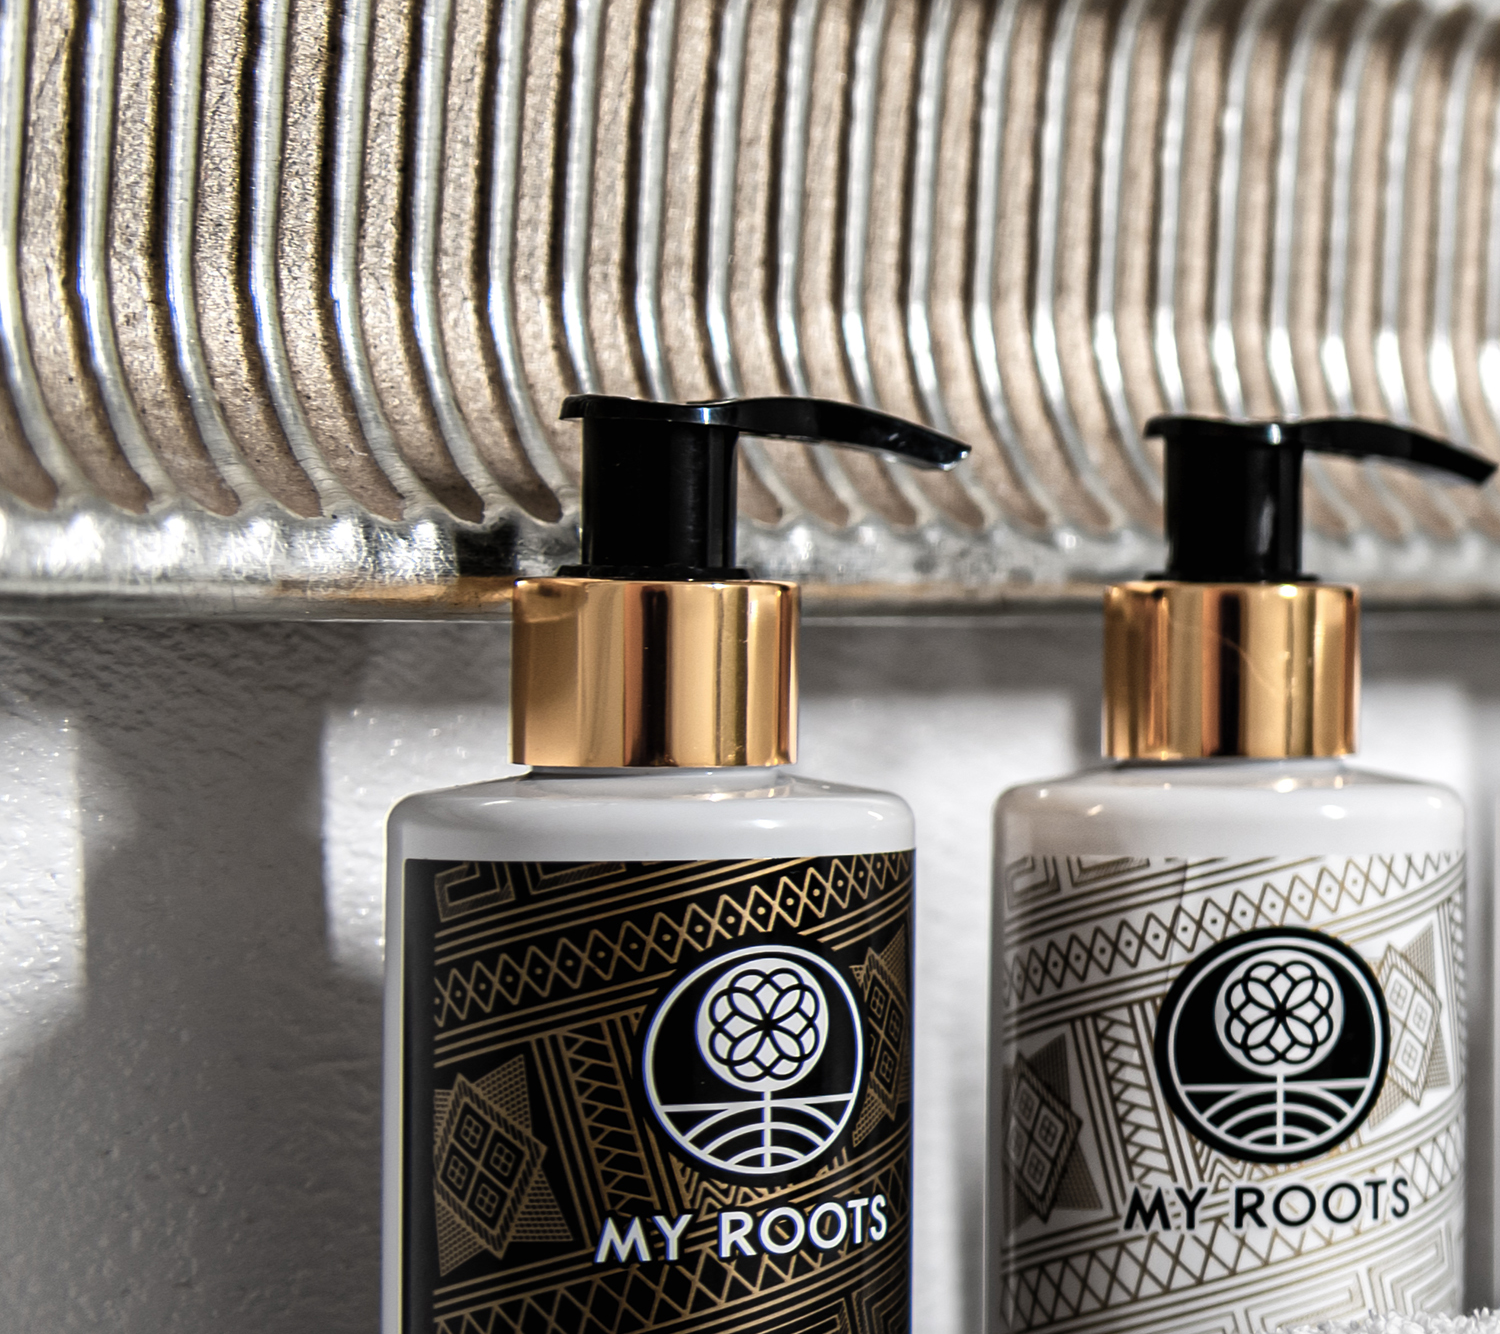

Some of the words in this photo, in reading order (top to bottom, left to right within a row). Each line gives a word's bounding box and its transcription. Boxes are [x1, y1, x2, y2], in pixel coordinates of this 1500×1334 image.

[595, 1214, 692, 1264] MY
[718, 1193, 888, 1258] ROOTS
[1123, 1185, 1208, 1230] MY
[1234, 1178, 1410, 1229] ROOTS
